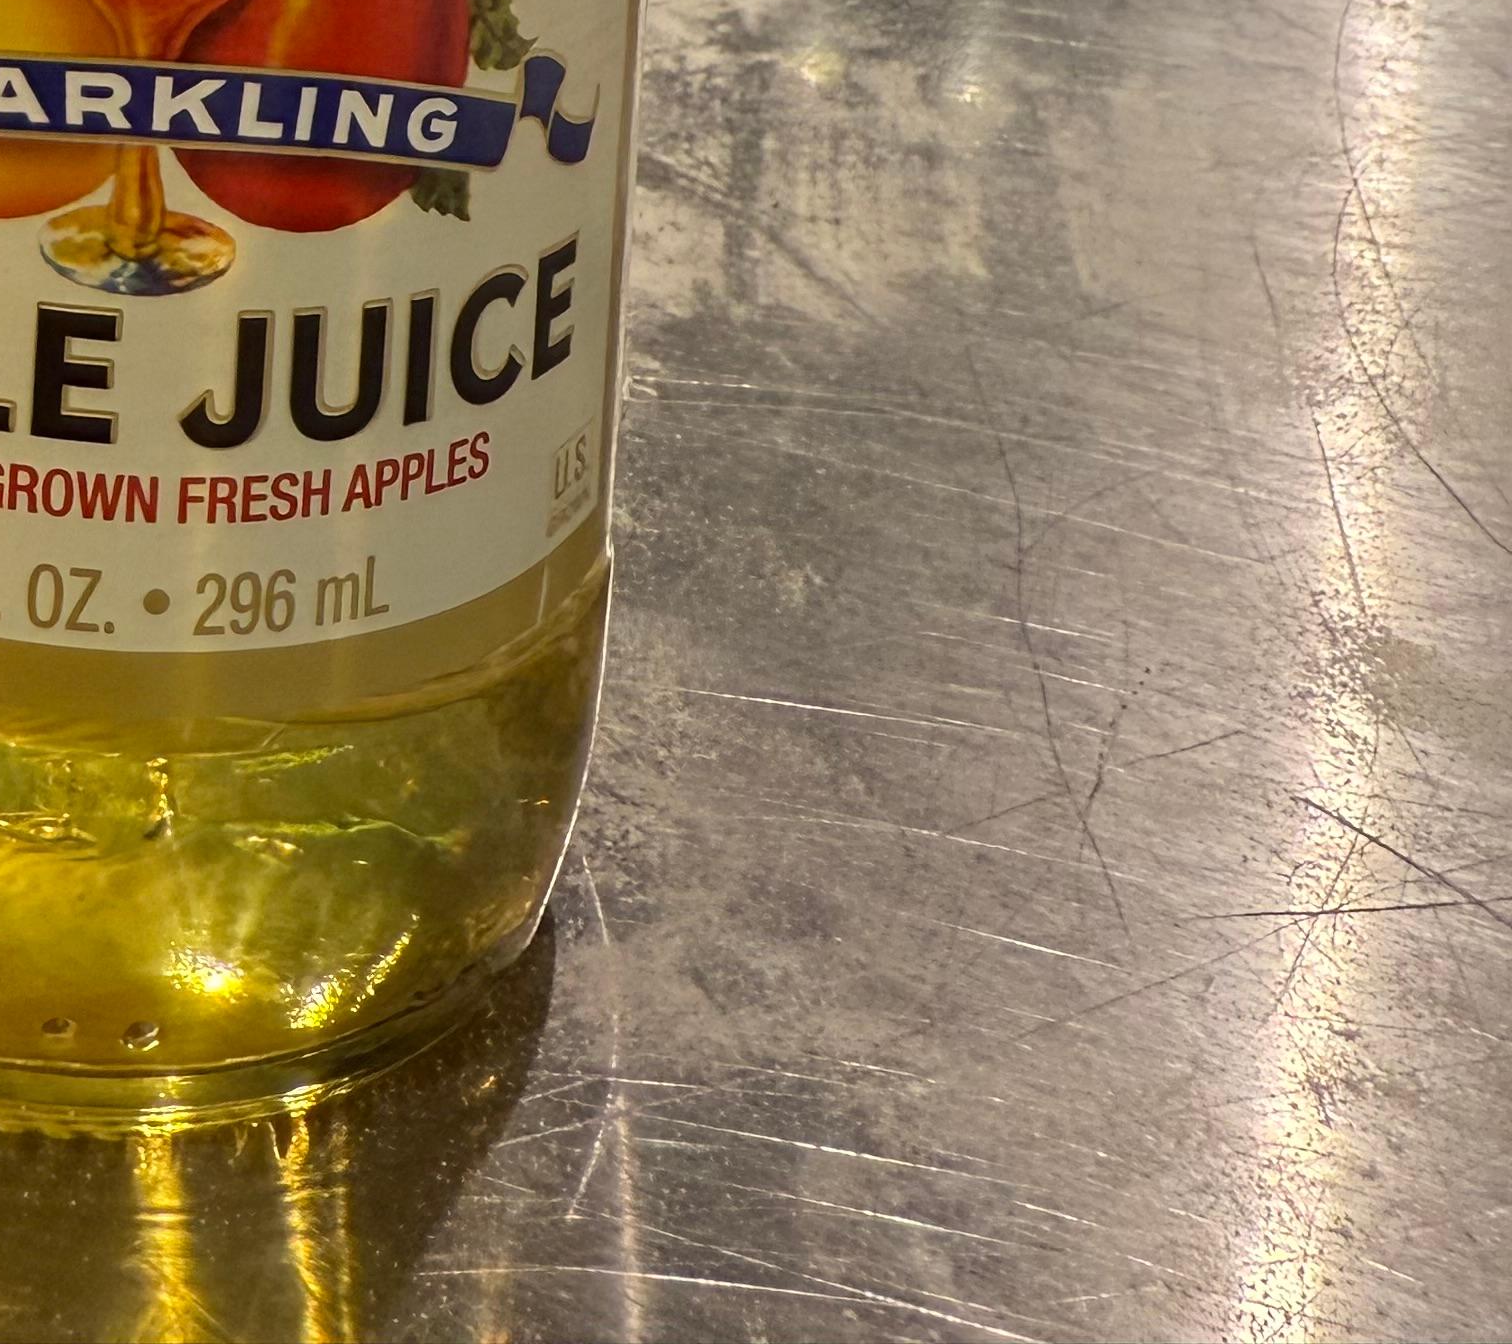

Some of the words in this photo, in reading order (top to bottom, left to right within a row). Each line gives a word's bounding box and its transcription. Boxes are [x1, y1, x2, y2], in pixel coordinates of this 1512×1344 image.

[178, 229, 580, 449] JUICE
[177, 468, 332, 525] FRESH
[341, 431, 490, 512] APPLES
[27, 562, 115, 635] OZ.
[193, 568, 296, 637] 296
[315, 555, 389, 626] mL
